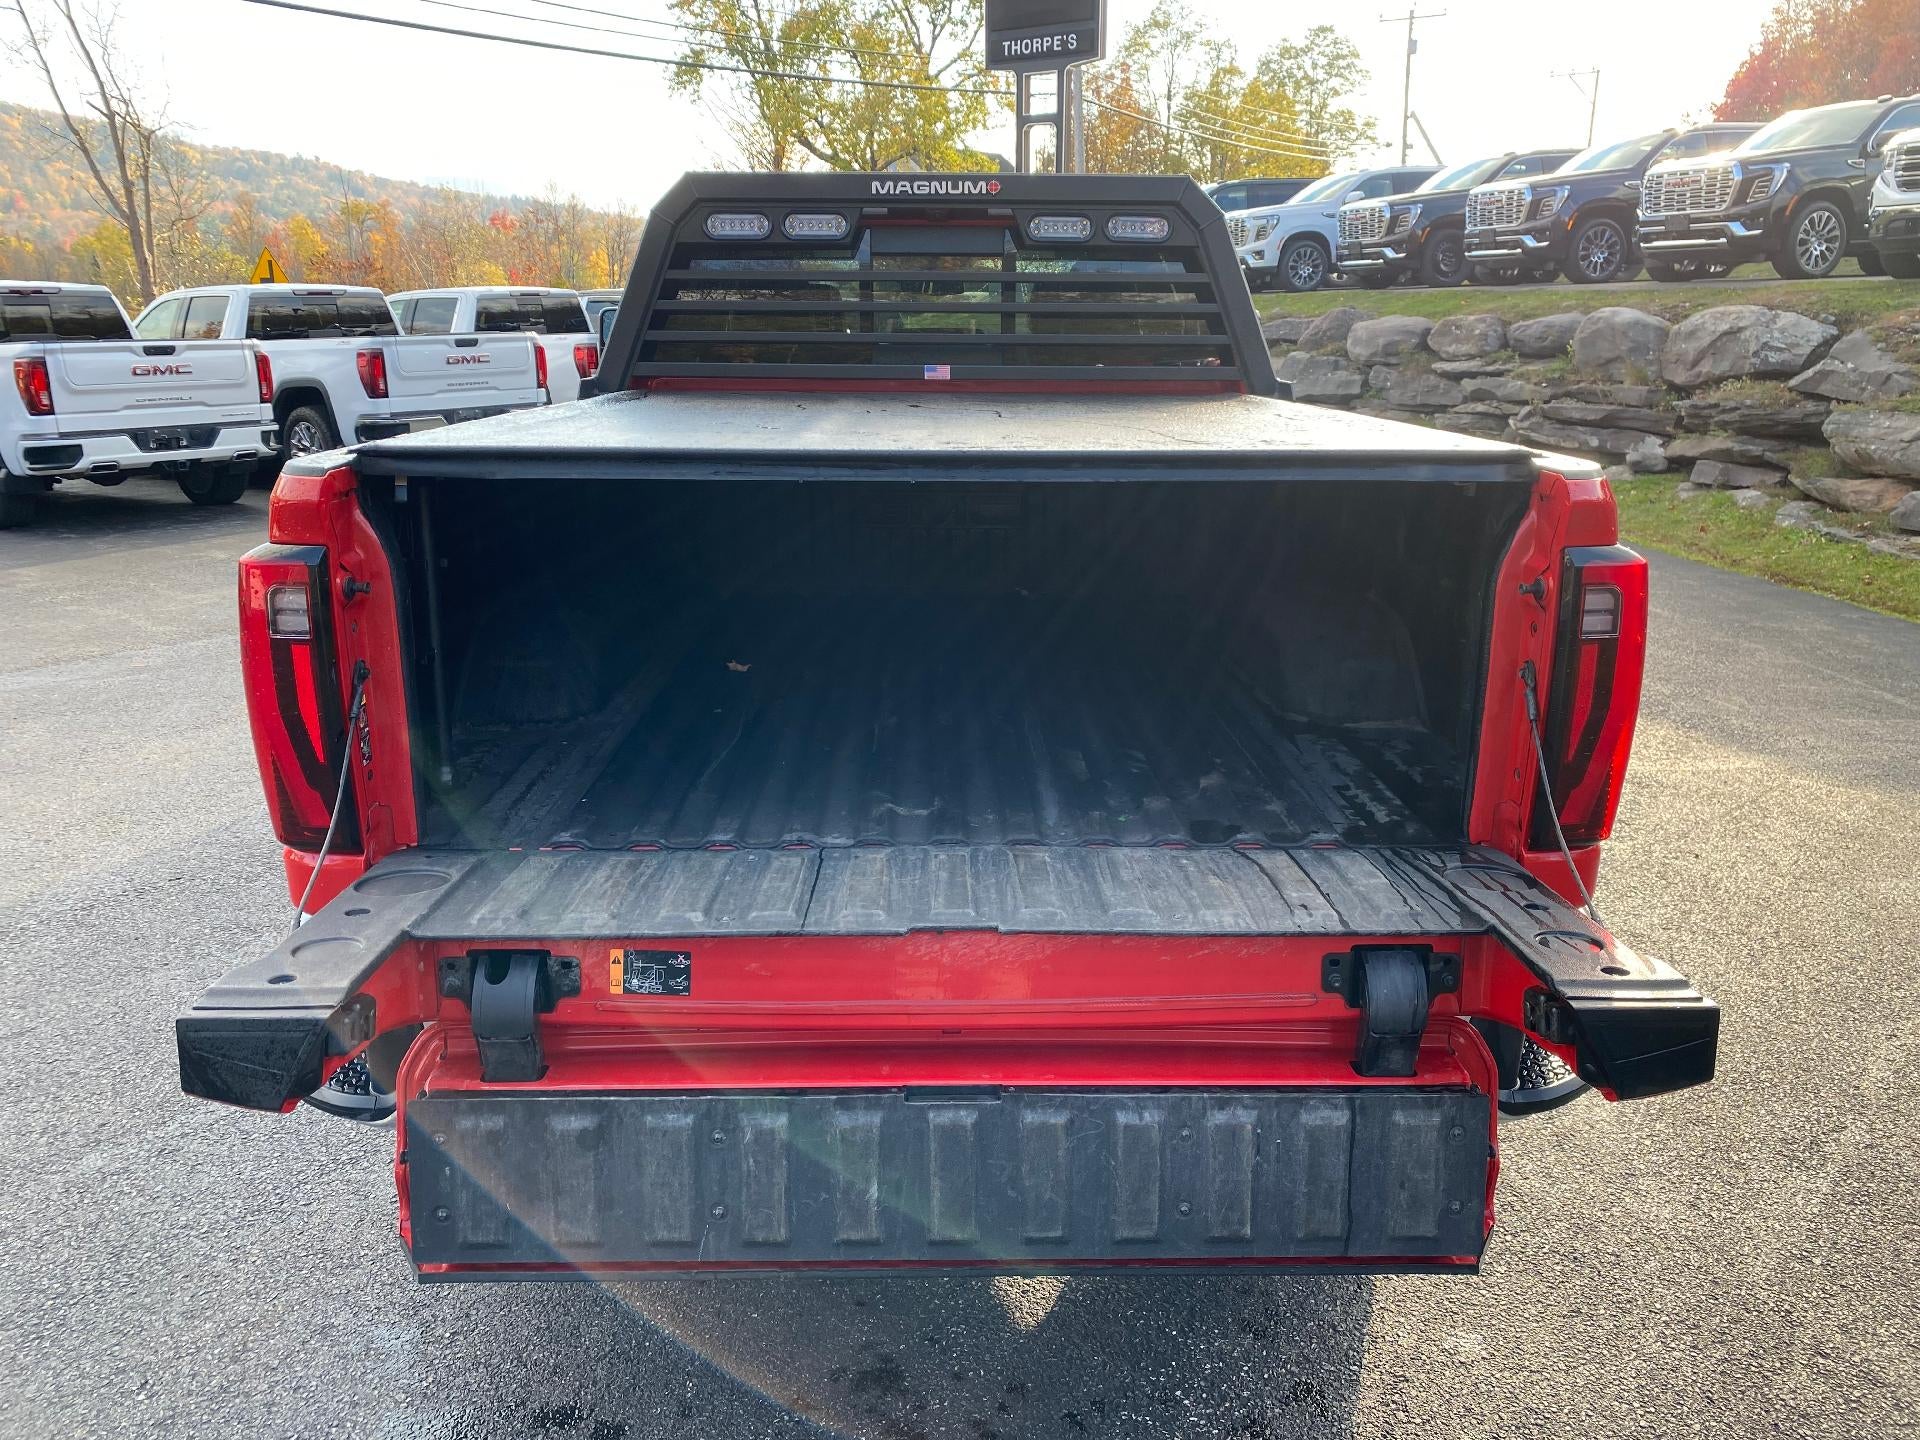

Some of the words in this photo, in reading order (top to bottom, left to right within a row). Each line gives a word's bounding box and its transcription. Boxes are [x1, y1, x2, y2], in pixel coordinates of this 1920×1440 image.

[1002, 33, 1077, 56] THORPE'S
[871, 180, 987, 195] MAGNUM
[446, 352, 491, 365] GMC
[130, 363, 193, 377] GMC
